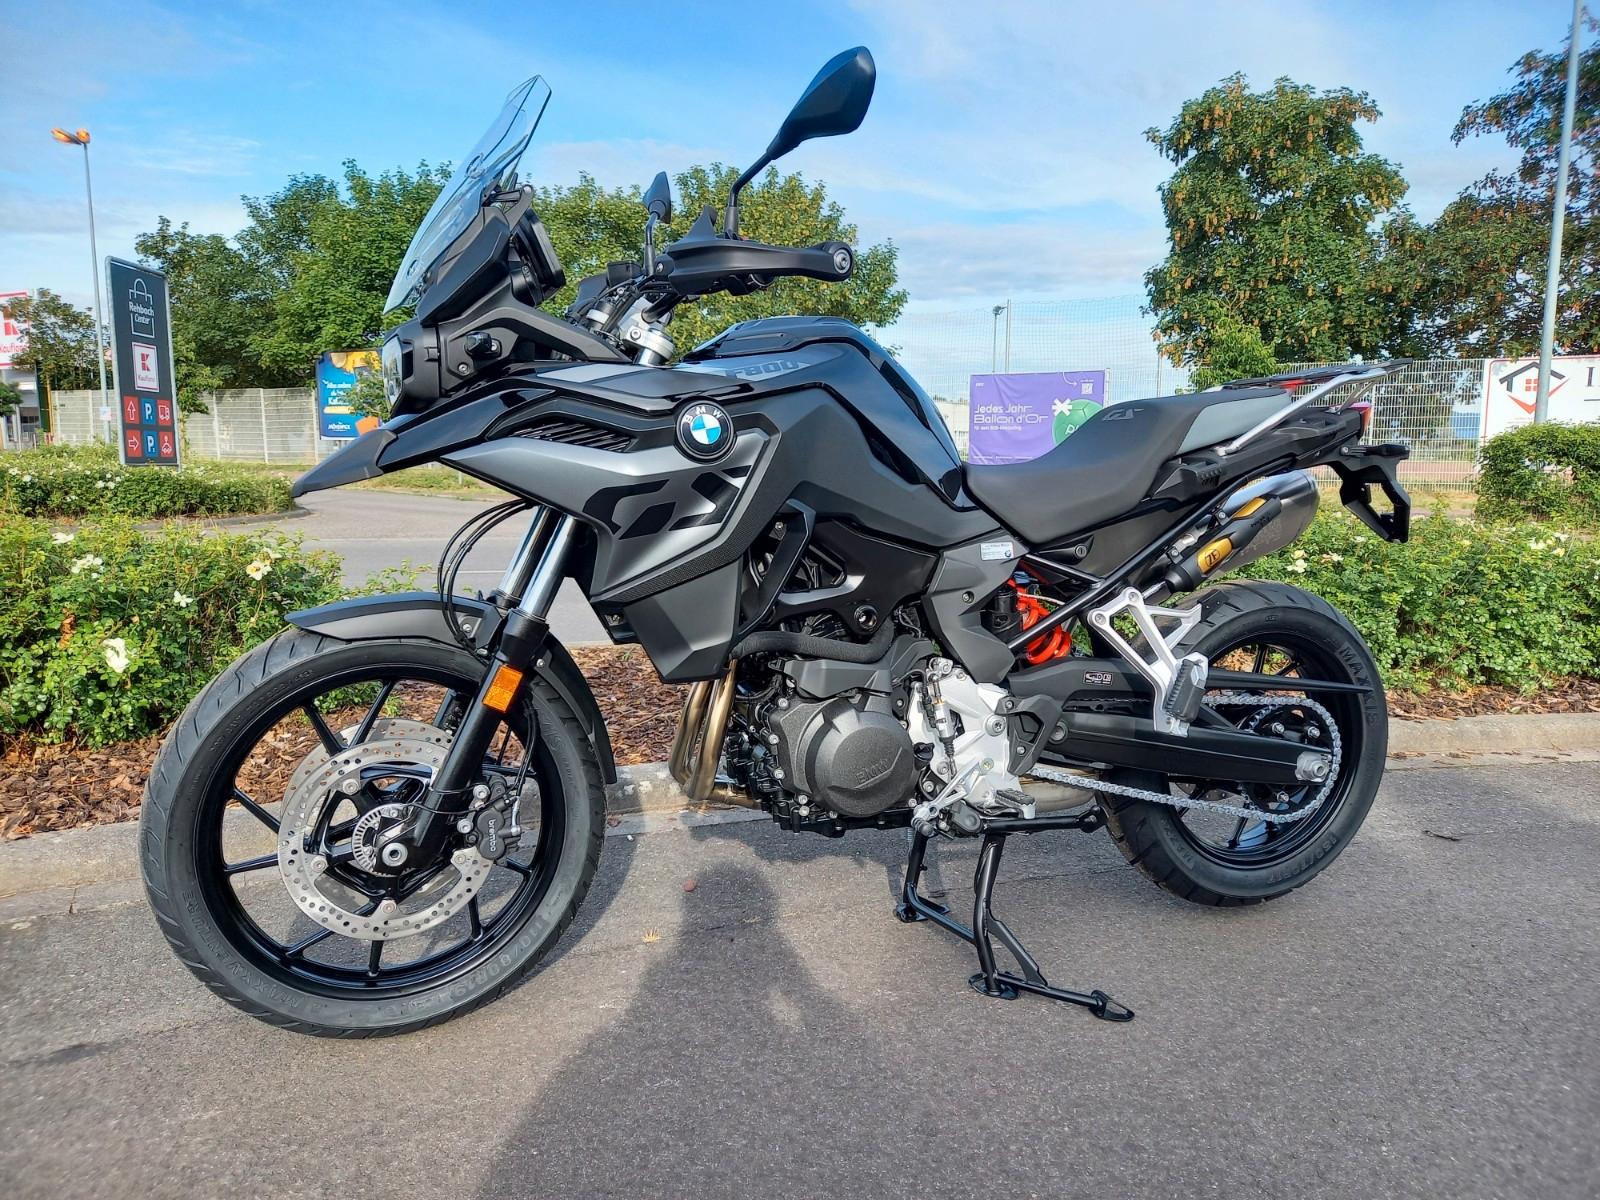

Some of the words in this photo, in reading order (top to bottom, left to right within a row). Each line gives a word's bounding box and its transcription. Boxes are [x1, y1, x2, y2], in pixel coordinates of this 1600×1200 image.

[128, 301, 155, 316] Rehbach
[725, 359, 800, 378] F800
[681, 405, 723, 424] BMW
[974, 403, 1004, 414] Jedes
[1005, 403, 1033, 414] Jahr
[974, 414, 1014, 424] Ballon
[488, 819, 497, 852] brembo
